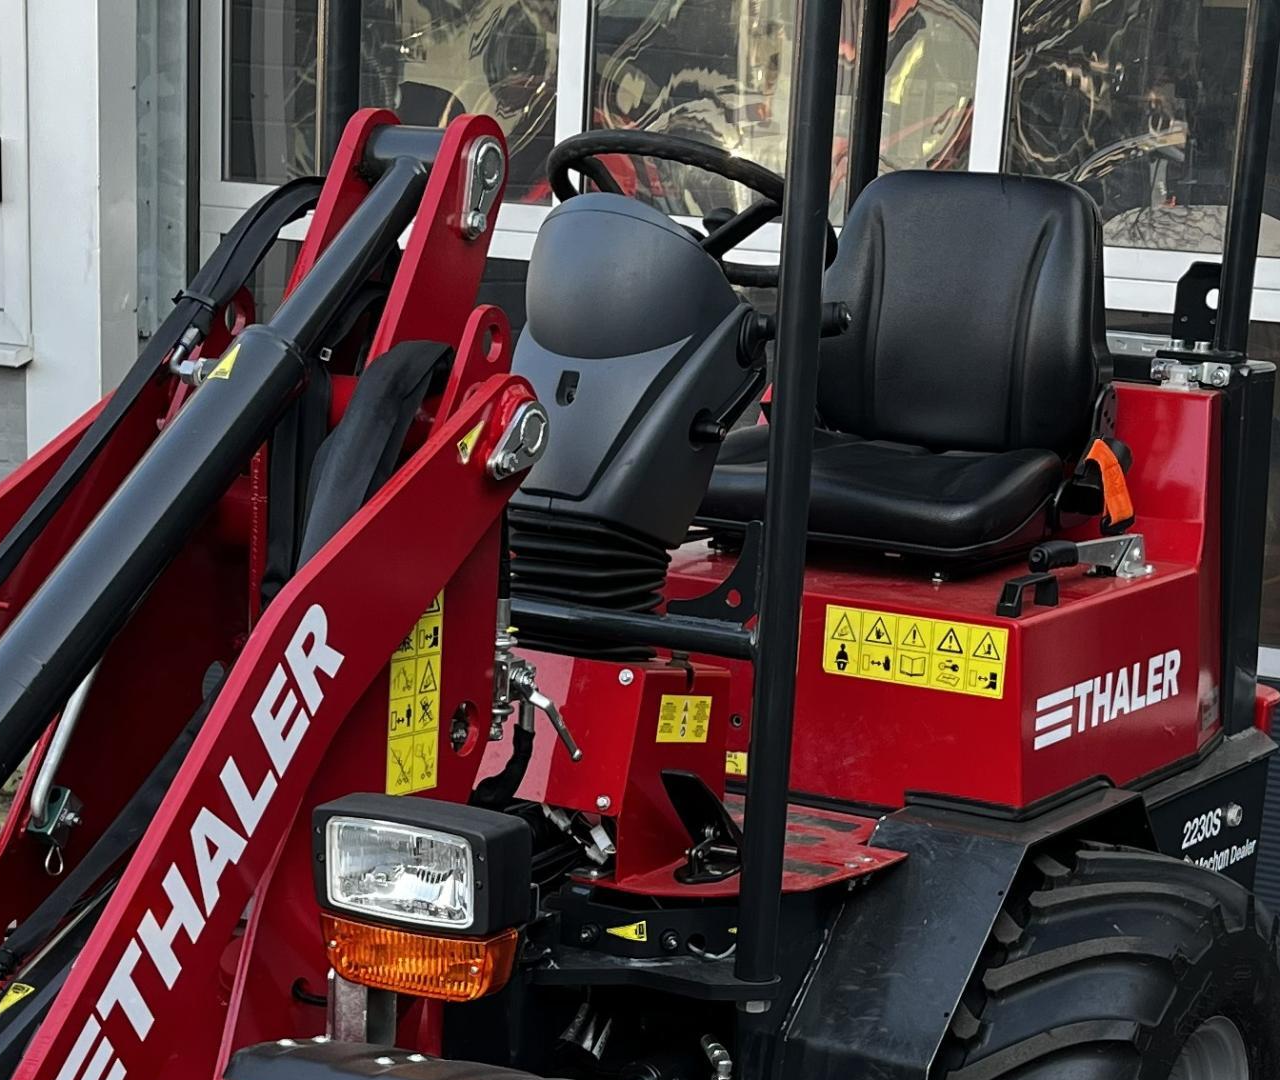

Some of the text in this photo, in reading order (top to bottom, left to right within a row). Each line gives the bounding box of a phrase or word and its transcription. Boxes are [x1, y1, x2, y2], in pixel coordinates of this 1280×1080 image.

[1071, 648, 1182, 735] THALER
[95, 603, 345, 1042] THALER
[1181, 807, 1222, 850] 2230S
[1230, 838, 1257, 865] Dealer
